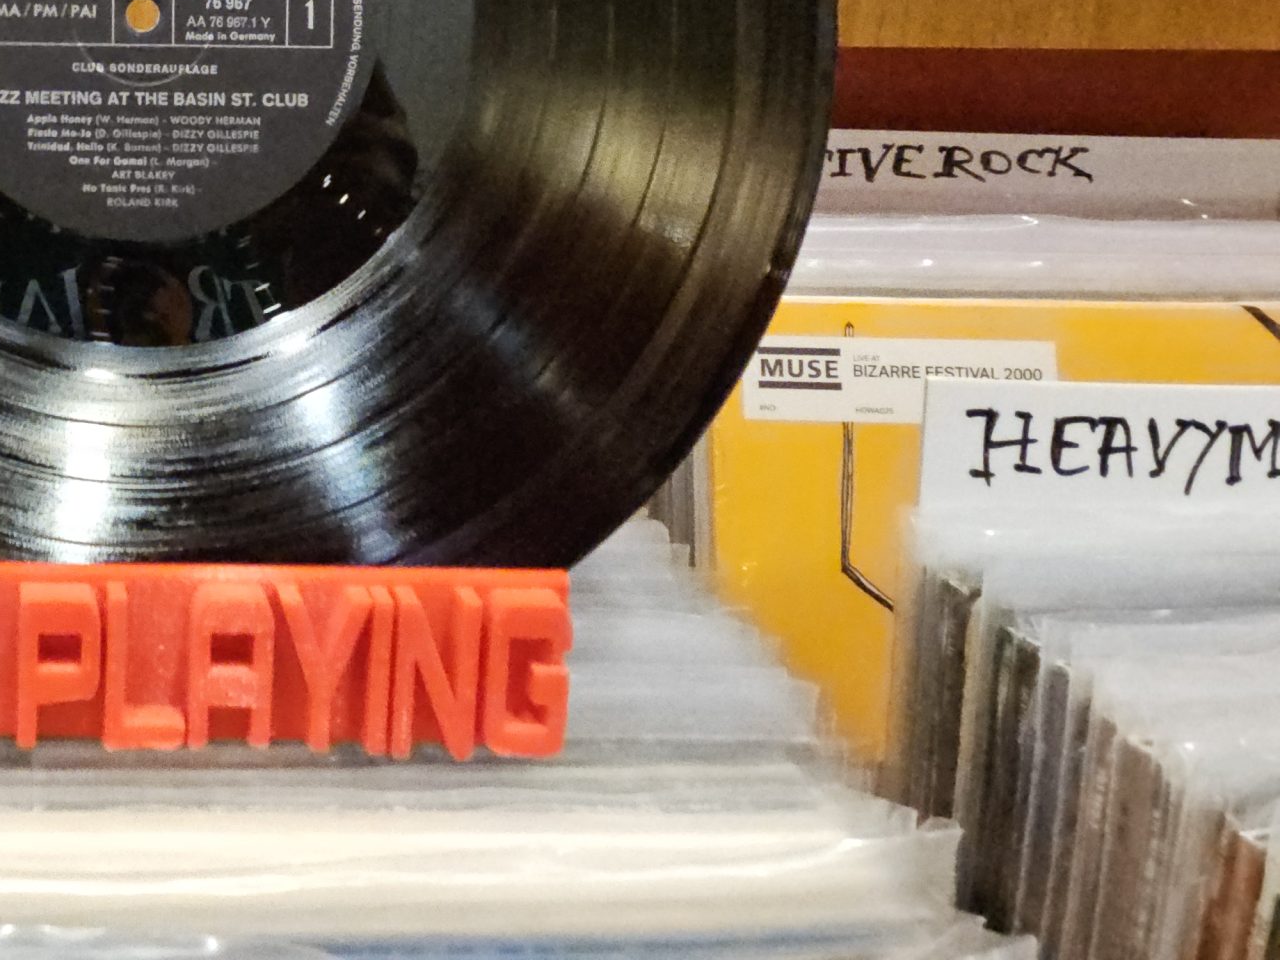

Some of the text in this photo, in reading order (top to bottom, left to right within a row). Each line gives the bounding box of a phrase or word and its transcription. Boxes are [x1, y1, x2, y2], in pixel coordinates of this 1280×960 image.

[186, 15, 206, 27] AA
[210, 16, 224, 28] 76
[304, 0, 315, 30] 1
[185, 31, 276, 42] Made in Germany
[72, 62, 104, 73] CLUB
[325, 54, 360, 128] VORBEHALTEN
[25, 90, 102, 106] MEETING
[107, 91, 130, 106] AT
[134, 91, 169, 106] THE
[173, 91, 226, 107] BASIN
[230, 92, 258, 107] ST.
[262, 92, 309, 108] CLUB
[169, 115, 212, 126] WOODY
[215, 115, 262, 127] HERMAN
[172, 129, 205, 140] DIZZY
[207, 129, 261, 140] GILLESPIE
[172, 143, 205, 153] DIZZY
[206, 143, 261, 154] GILLESPIE
[759, 357, 840, 380] MUSE
[853, 364, 921, 379] BIZARRE
[1003, 367, 1044, 382] 2000
[18, 580, 576, 762] PLAYING
